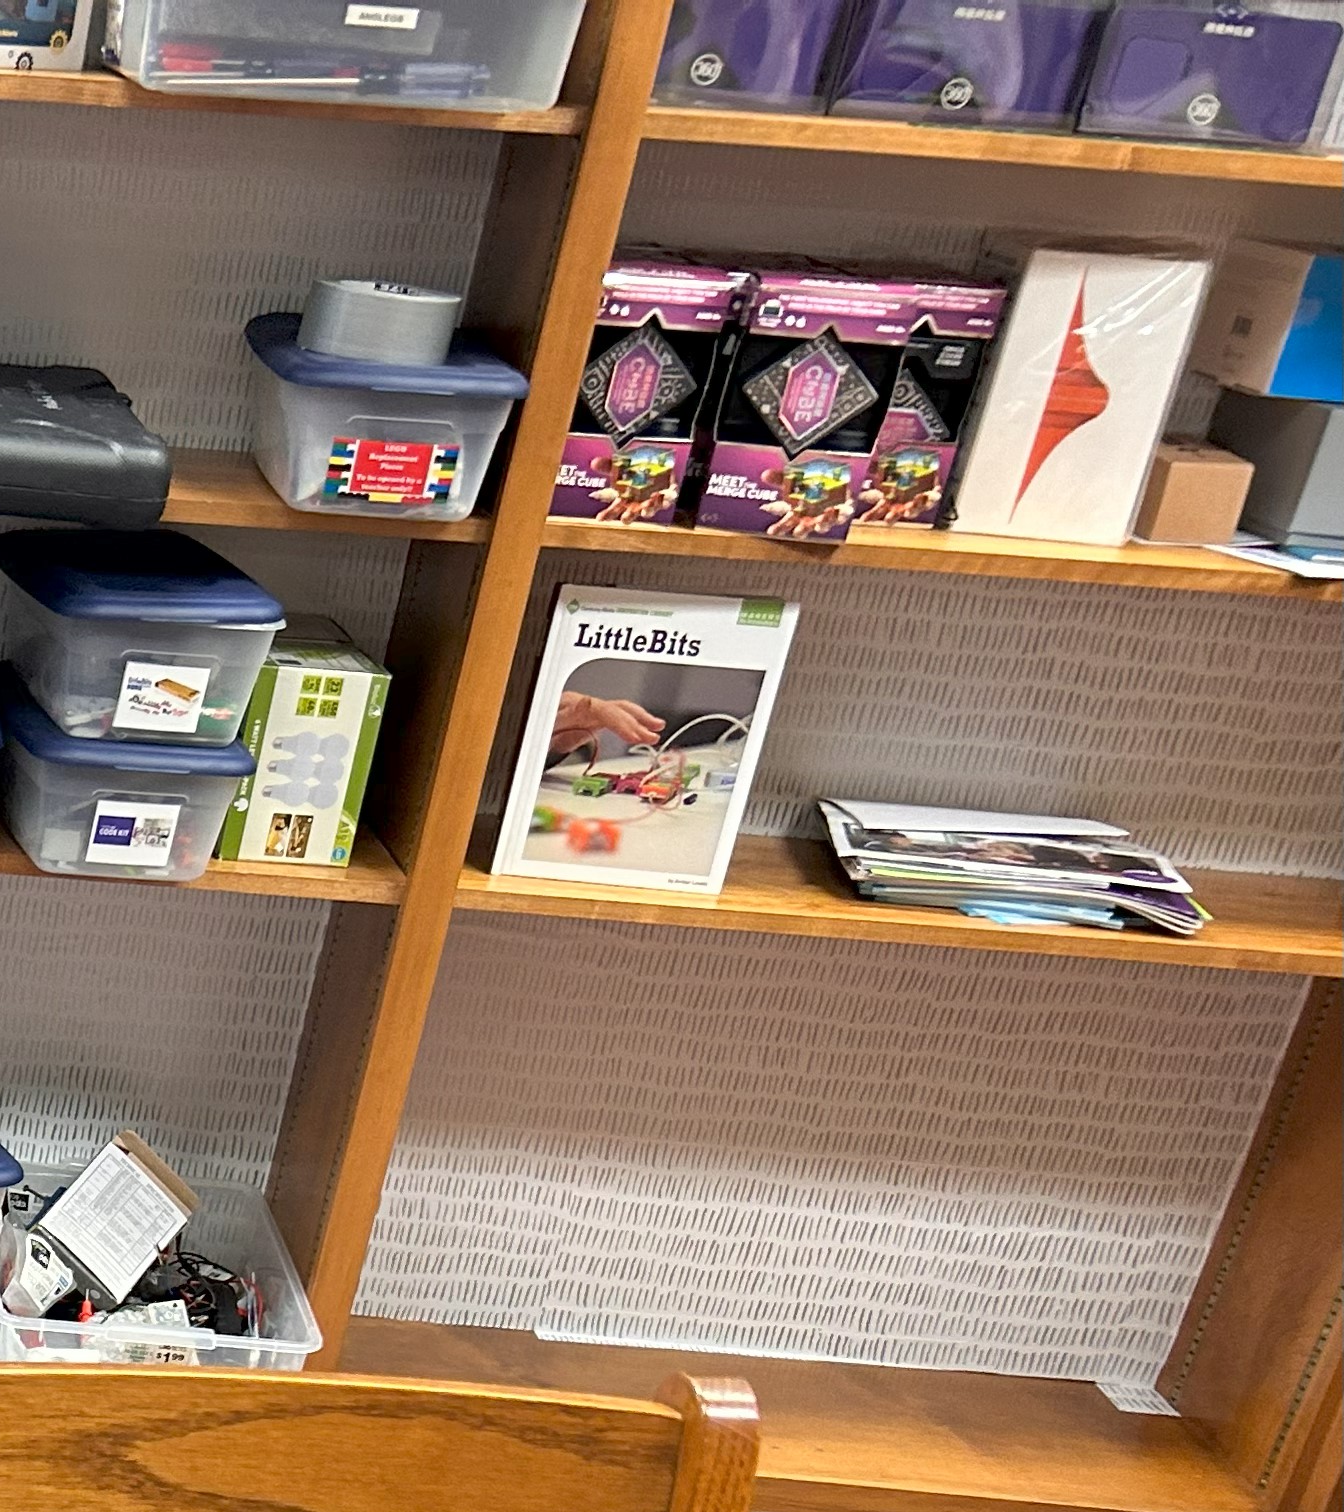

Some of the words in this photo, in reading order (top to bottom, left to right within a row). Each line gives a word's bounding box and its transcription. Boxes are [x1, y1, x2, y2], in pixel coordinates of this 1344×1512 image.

[708, 473, 747, 488] MEET
[706, 486, 747, 499] MERGE
[747, 489, 779, 501] CUBE
[573, 623, 702, 657] LittleBits
